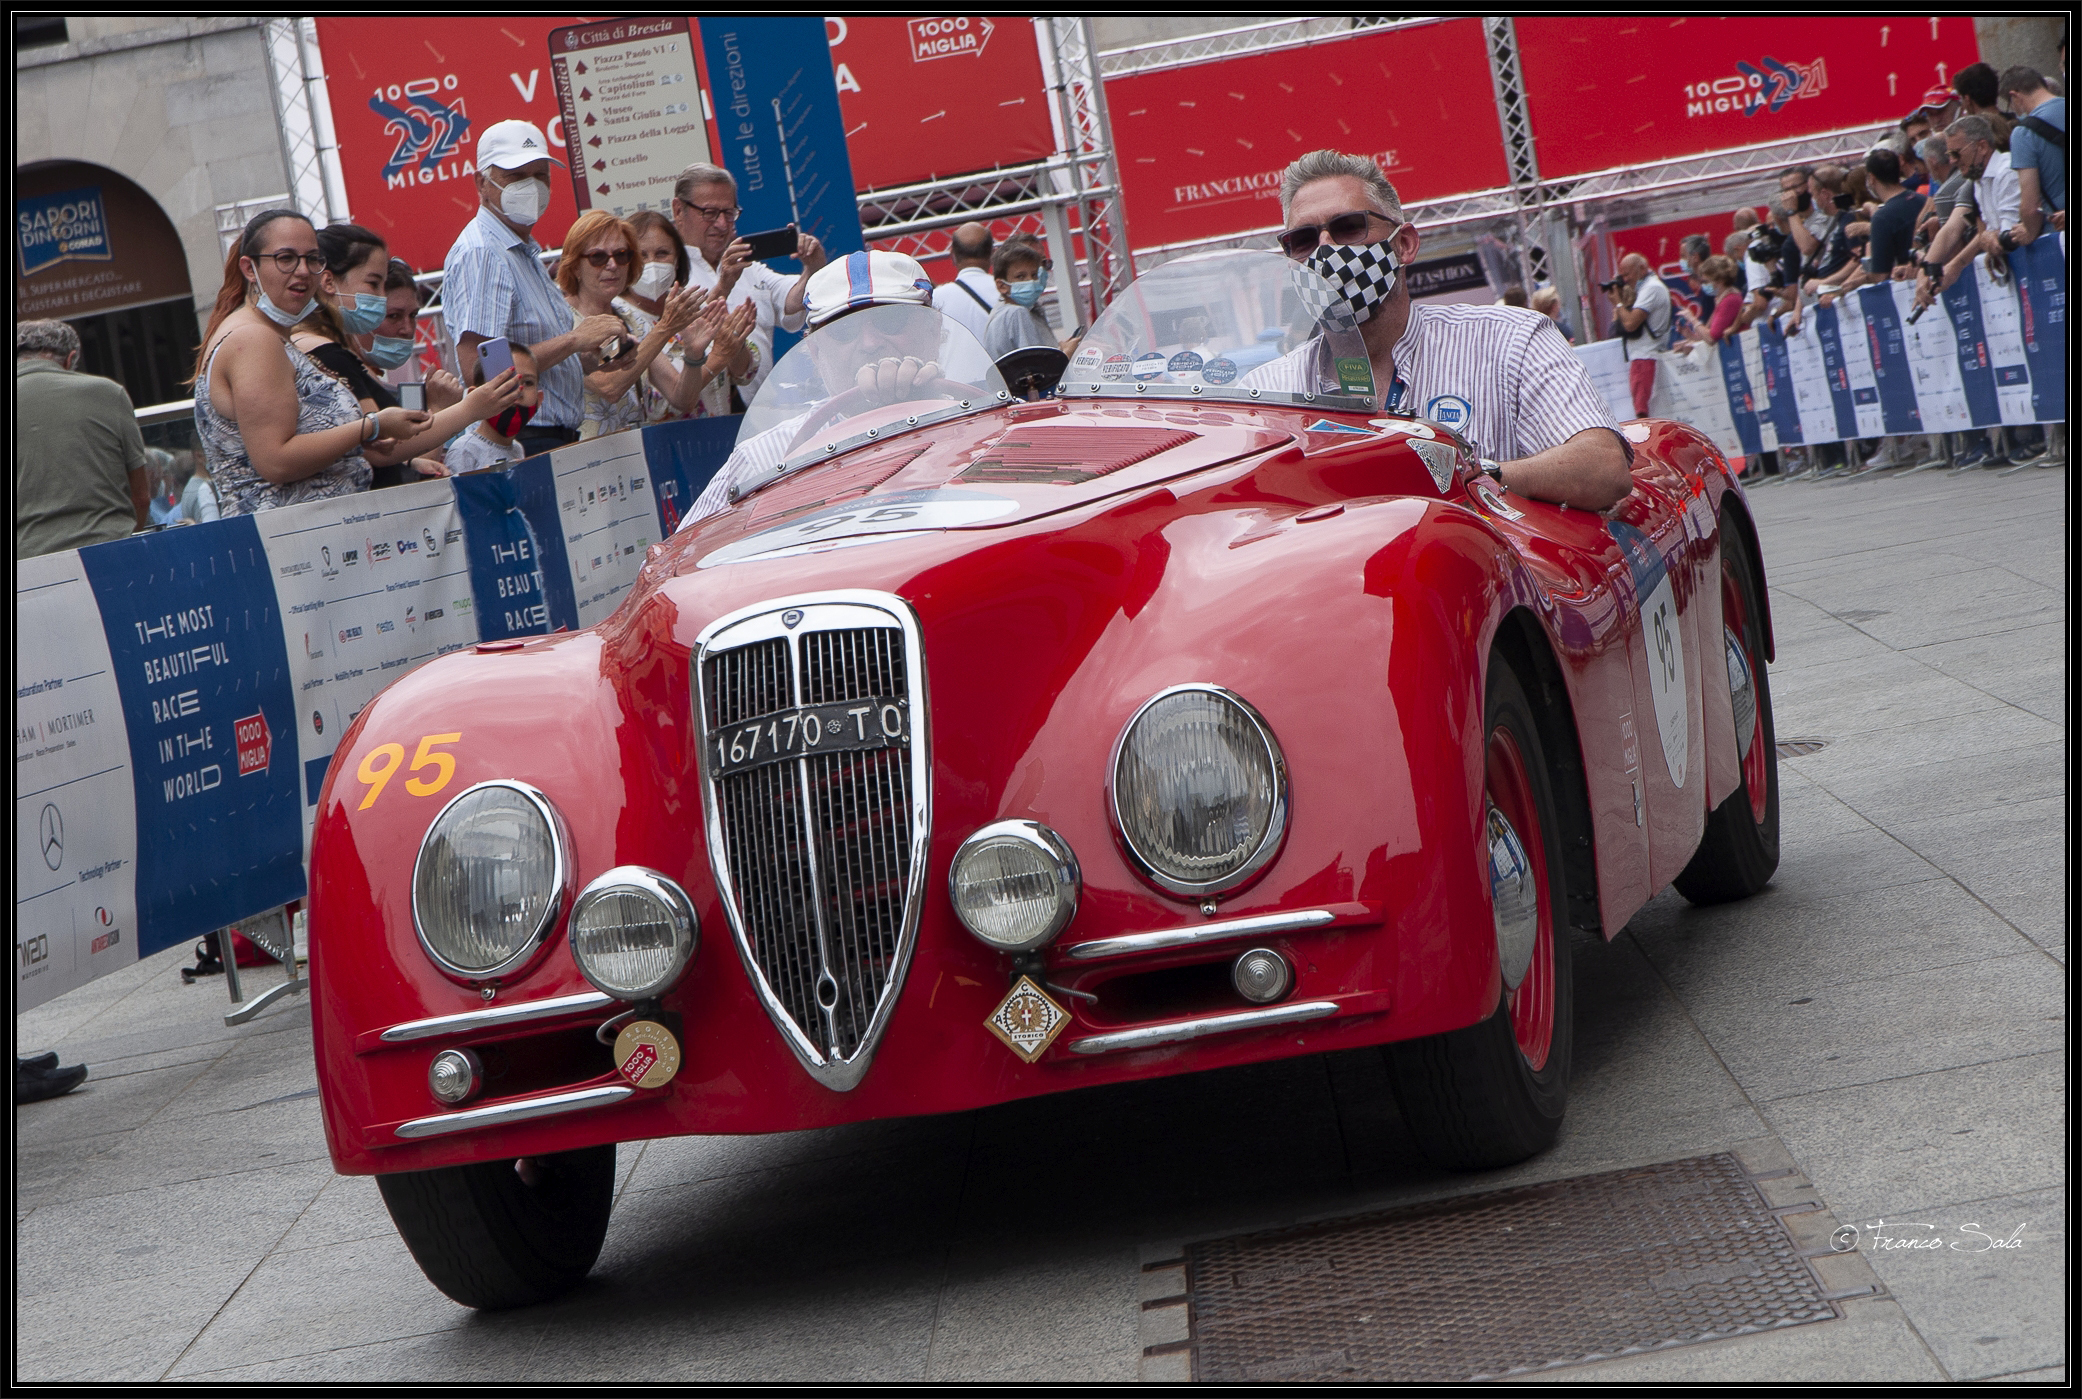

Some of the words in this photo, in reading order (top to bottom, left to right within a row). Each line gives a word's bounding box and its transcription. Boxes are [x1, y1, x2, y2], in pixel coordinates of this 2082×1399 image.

[581, 30, 610, 45] Città
[613, 26, 625, 39] di
[628, 20, 673, 37] Brescia
[917, 17, 969, 37] 1000
[593, 54, 624, 65] Piazza
[626, 48, 652, 60] Paolo
[653, 44, 666, 54] VI
[918, 33, 977, 57] MIGLIA
[599, 79, 656, 95] Capitolium
[718, 31, 751, 118] direzioni
[1768, 56, 1829, 103] 2021
[602, 105, 634, 116] Museo
[1686, 91, 1768, 117] MIGLIA
[603, 116, 631, 127] Santa
[632, 110, 662, 122] Giulia
[735, 122, 754, 141] le
[607, 134, 638, 145] Piazza
[639, 128, 662, 139] della
[663, 123, 696, 136] Loggia
[611, 153, 649, 167] Castello
[743, 143, 764, 192] tutte
[387, 158, 476, 191] MIGLIA
[615, 179, 647, 191] Museo
[19, 199, 99, 233] SAPORI
[68, 235, 104, 252] CONAD
[1102, 363, 1131, 374] VERIFICATO
[1439, 406, 1461, 422] LANCIA
[799, 506, 924, 536] 95
[490, 539, 530, 565] THE
[134, 614, 177, 646] THE
[177, 604, 215, 635] MOST
[505, 604, 548, 633] RACE
[1653, 600, 1677, 695] 95
[144, 641, 230, 685] BEAUTIFUL
[152, 689, 201, 725] RACE
[47, 707, 96, 736] MORTIMER
[238, 721, 262, 745] 1000
[158, 737, 175, 765] IN
[176, 725, 214, 759] THE
[716, 713, 822, 768] 167170
[239, 745, 267, 770] MIGLIA
[162, 763, 222, 804] WORLD
[356, 731, 463, 812] 95
[1013, 1032, 1045, 1041] STORICO
[624, 1050, 645, 1074] 1000
[630, 1055, 654, 1082] MIGLIA
